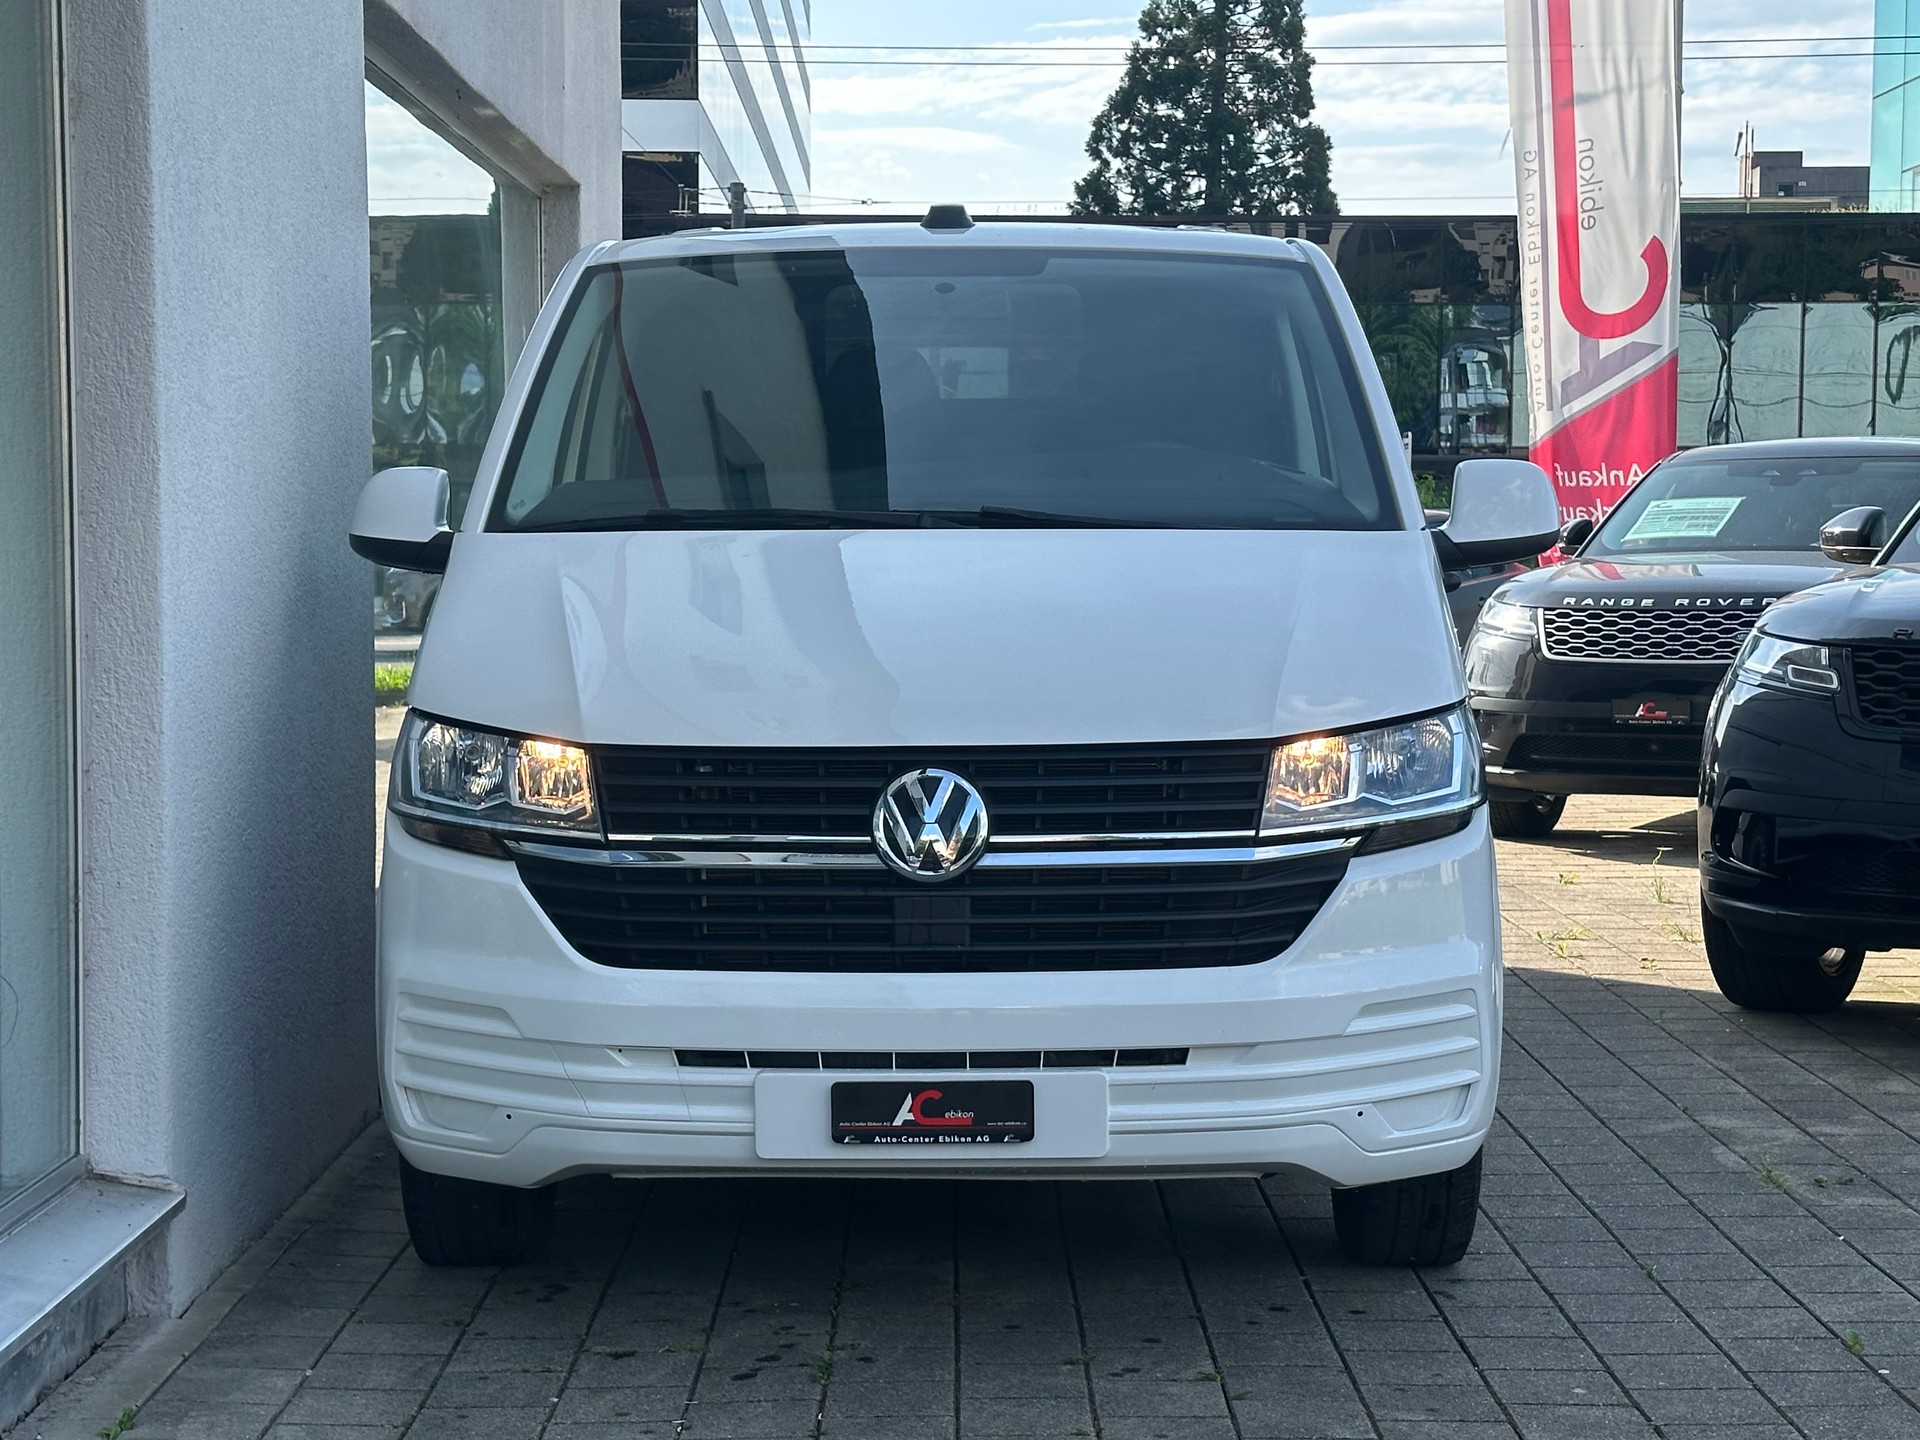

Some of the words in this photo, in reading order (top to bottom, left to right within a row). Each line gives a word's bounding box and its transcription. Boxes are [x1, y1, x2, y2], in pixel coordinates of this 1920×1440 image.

[1562, 597, 1655, 607] RANGE
[1674, 597, 1778, 607] ROVER
[944, 1109, 974, 1119] ebikon
[874, 1135, 935, 1143] Auto-Center
[938, 1135, 972, 1143] Ebikon
[975, 1135, 990, 1143] AG
